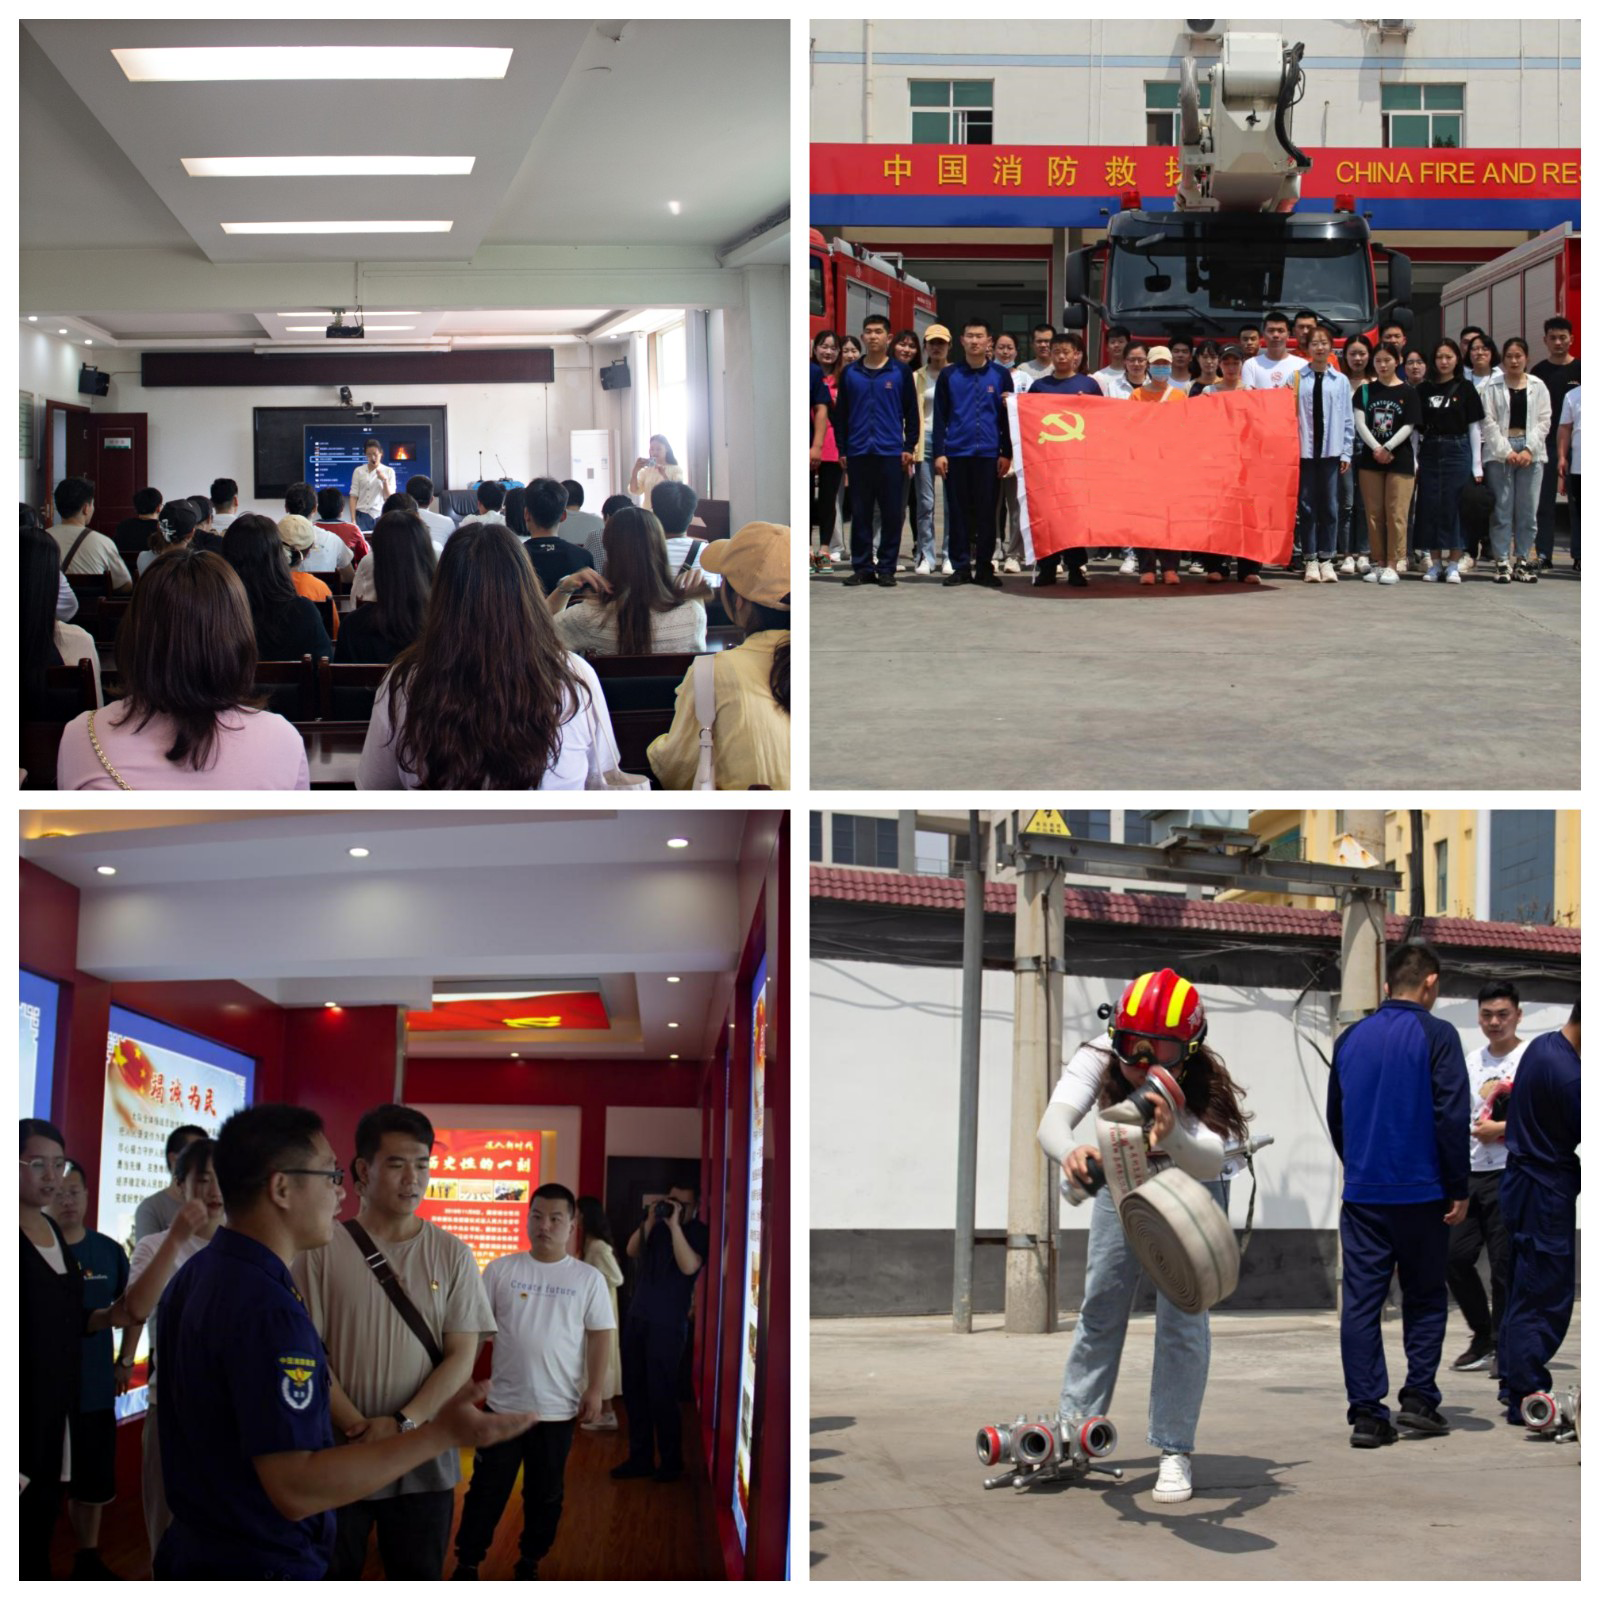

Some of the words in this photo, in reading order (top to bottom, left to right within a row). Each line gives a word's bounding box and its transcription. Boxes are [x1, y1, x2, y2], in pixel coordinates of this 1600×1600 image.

[1336, 161, 1413, 184] CHINA
[1420, 162, 1475, 184] FIRE
[1482, 162, 1537, 184] AND
[510, 1279, 542, 1292] Create
[545, 1284, 577, 1297] future
